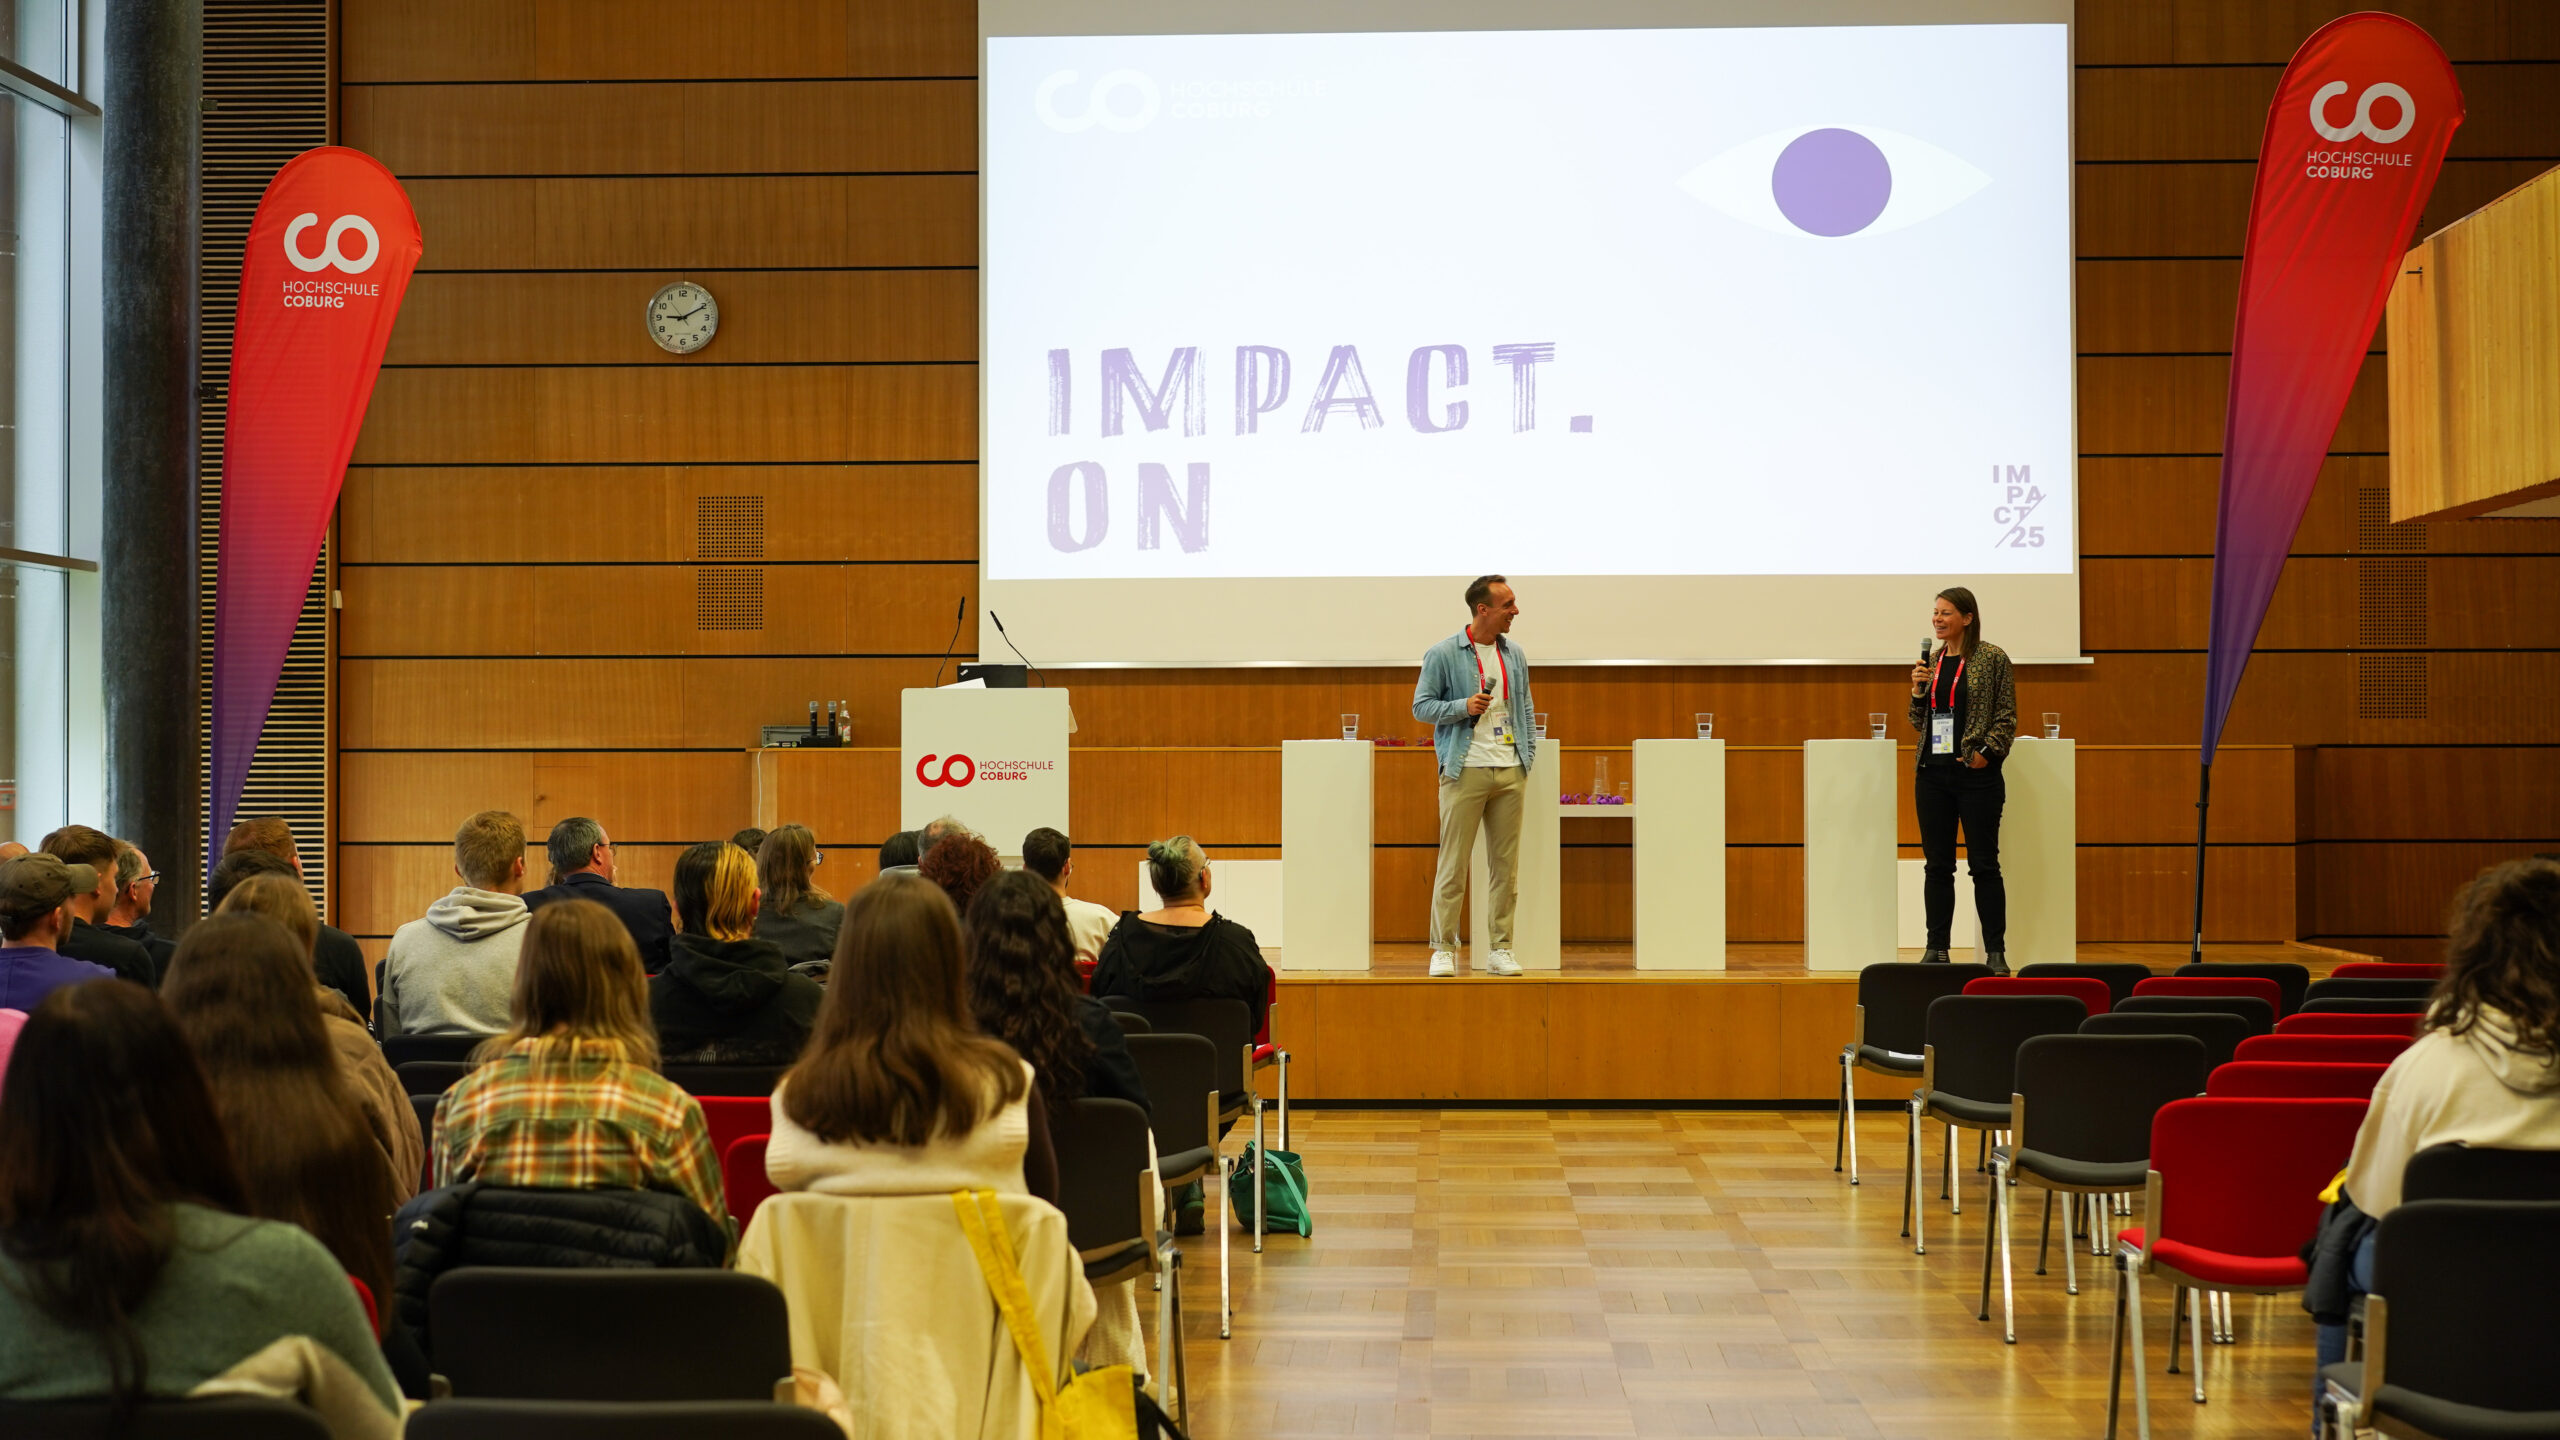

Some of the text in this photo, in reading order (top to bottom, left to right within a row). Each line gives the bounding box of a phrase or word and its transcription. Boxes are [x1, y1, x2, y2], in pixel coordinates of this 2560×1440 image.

[1170, 80, 1328, 97] HOCHSCHULE
[1170, 101, 1272, 120] COBURG
[2307, 150, 2413, 167] HOCHSCHULE
[2306, 165, 2374, 180] COBURG
[282, 280, 380, 297] HOCHSCHULE
[283, 295, 345, 309] COBURG
[659, 302, 667, 310] 10
[701, 302, 707, 310] 2
[659, 325, 665, 333] 8
[667, 334, 673, 342] 7
[679, 338, 686, 346] 6
[692, 334, 699, 342] 5
[1047, 341, 1594, 438] IMPACT.
[1993, 465, 2030, 483] IM
[2007, 485, 2043, 504] PA
[1047, 459, 1211, 554] ON
[979, 760, 1054, 770] HOCHSCHULE
[980, 771, 1028, 781] COBURG
